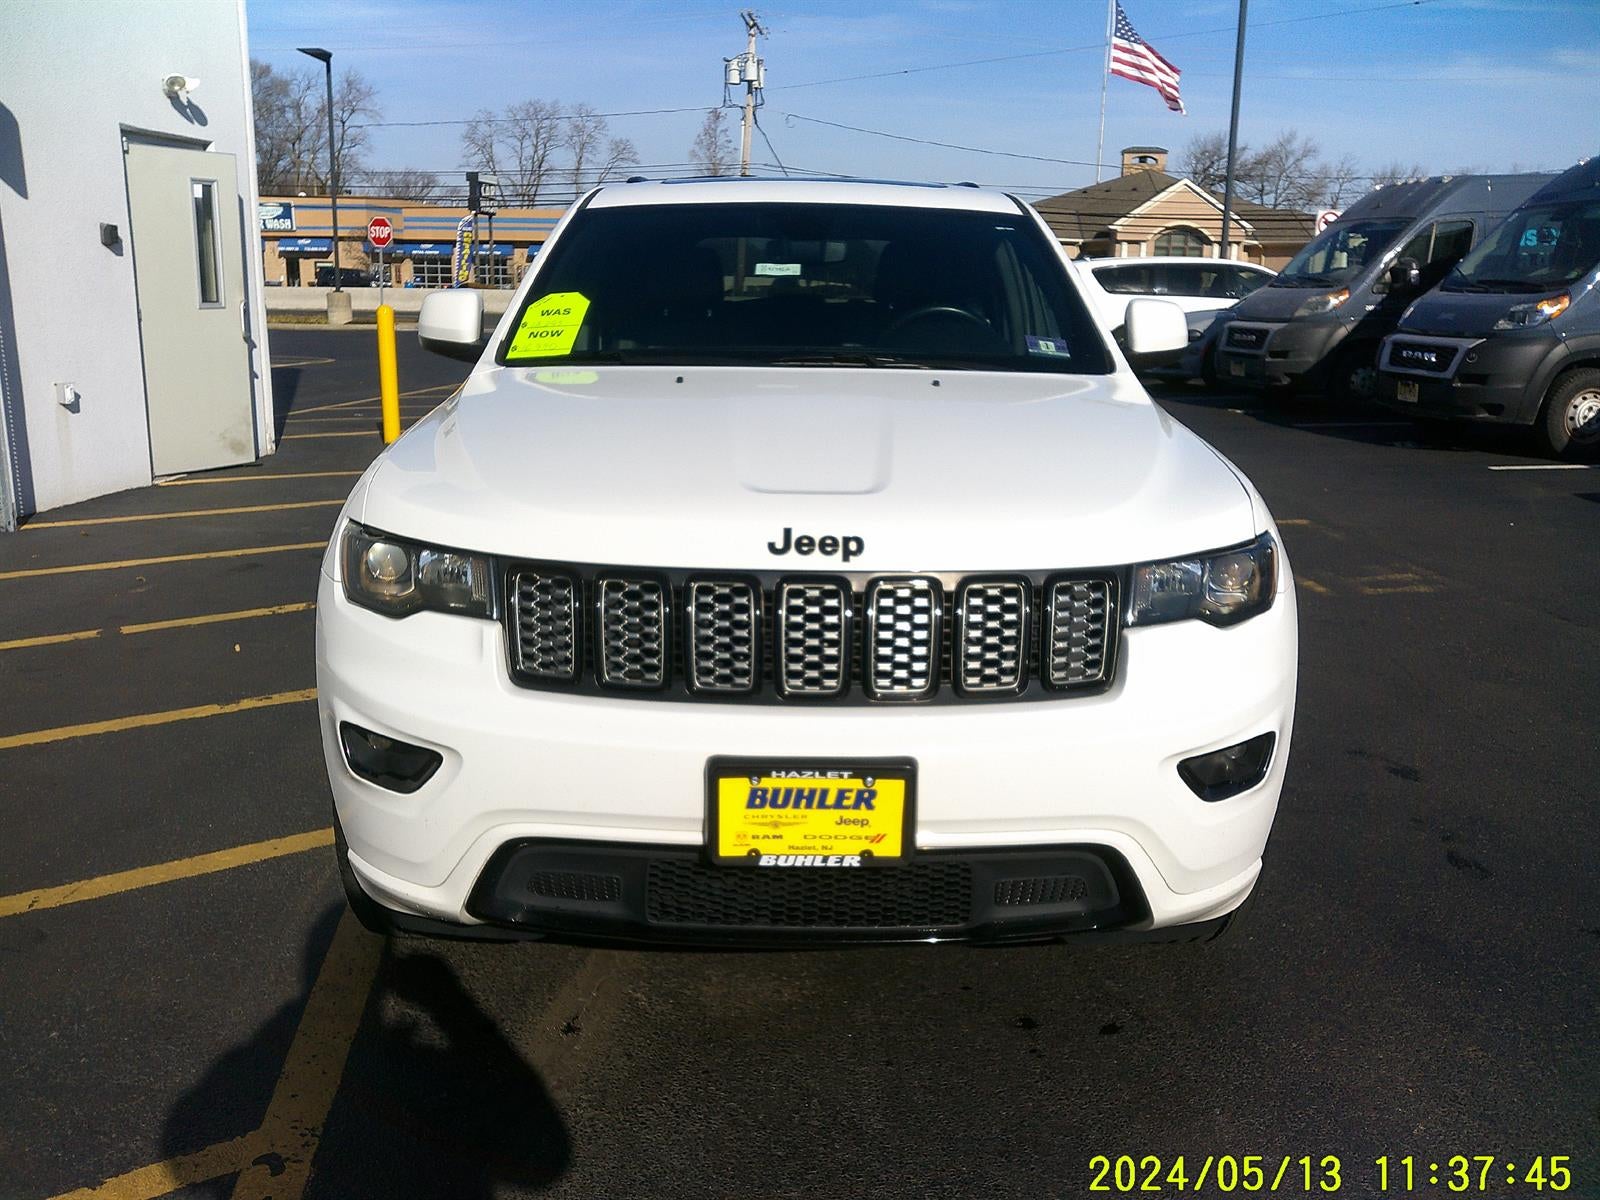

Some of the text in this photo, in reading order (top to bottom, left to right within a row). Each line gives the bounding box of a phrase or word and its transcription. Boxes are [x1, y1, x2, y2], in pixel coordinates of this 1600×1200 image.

[265, 218, 291, 230] WASH
[370, 225, 391, 239] STOP
[540, 307, 572, 317] WAS
[527, 329, 565, 339] NOW
[767, 527, 865, 563] Jeep
[770, 770, 853, 779] HAZLET
[745, 786, 878, 811] BUHLER
[834, 815, 870, 828] Jeep
[803, 833, 875, 841] DODGE
[758, 855, 862, 867] BUHLER
